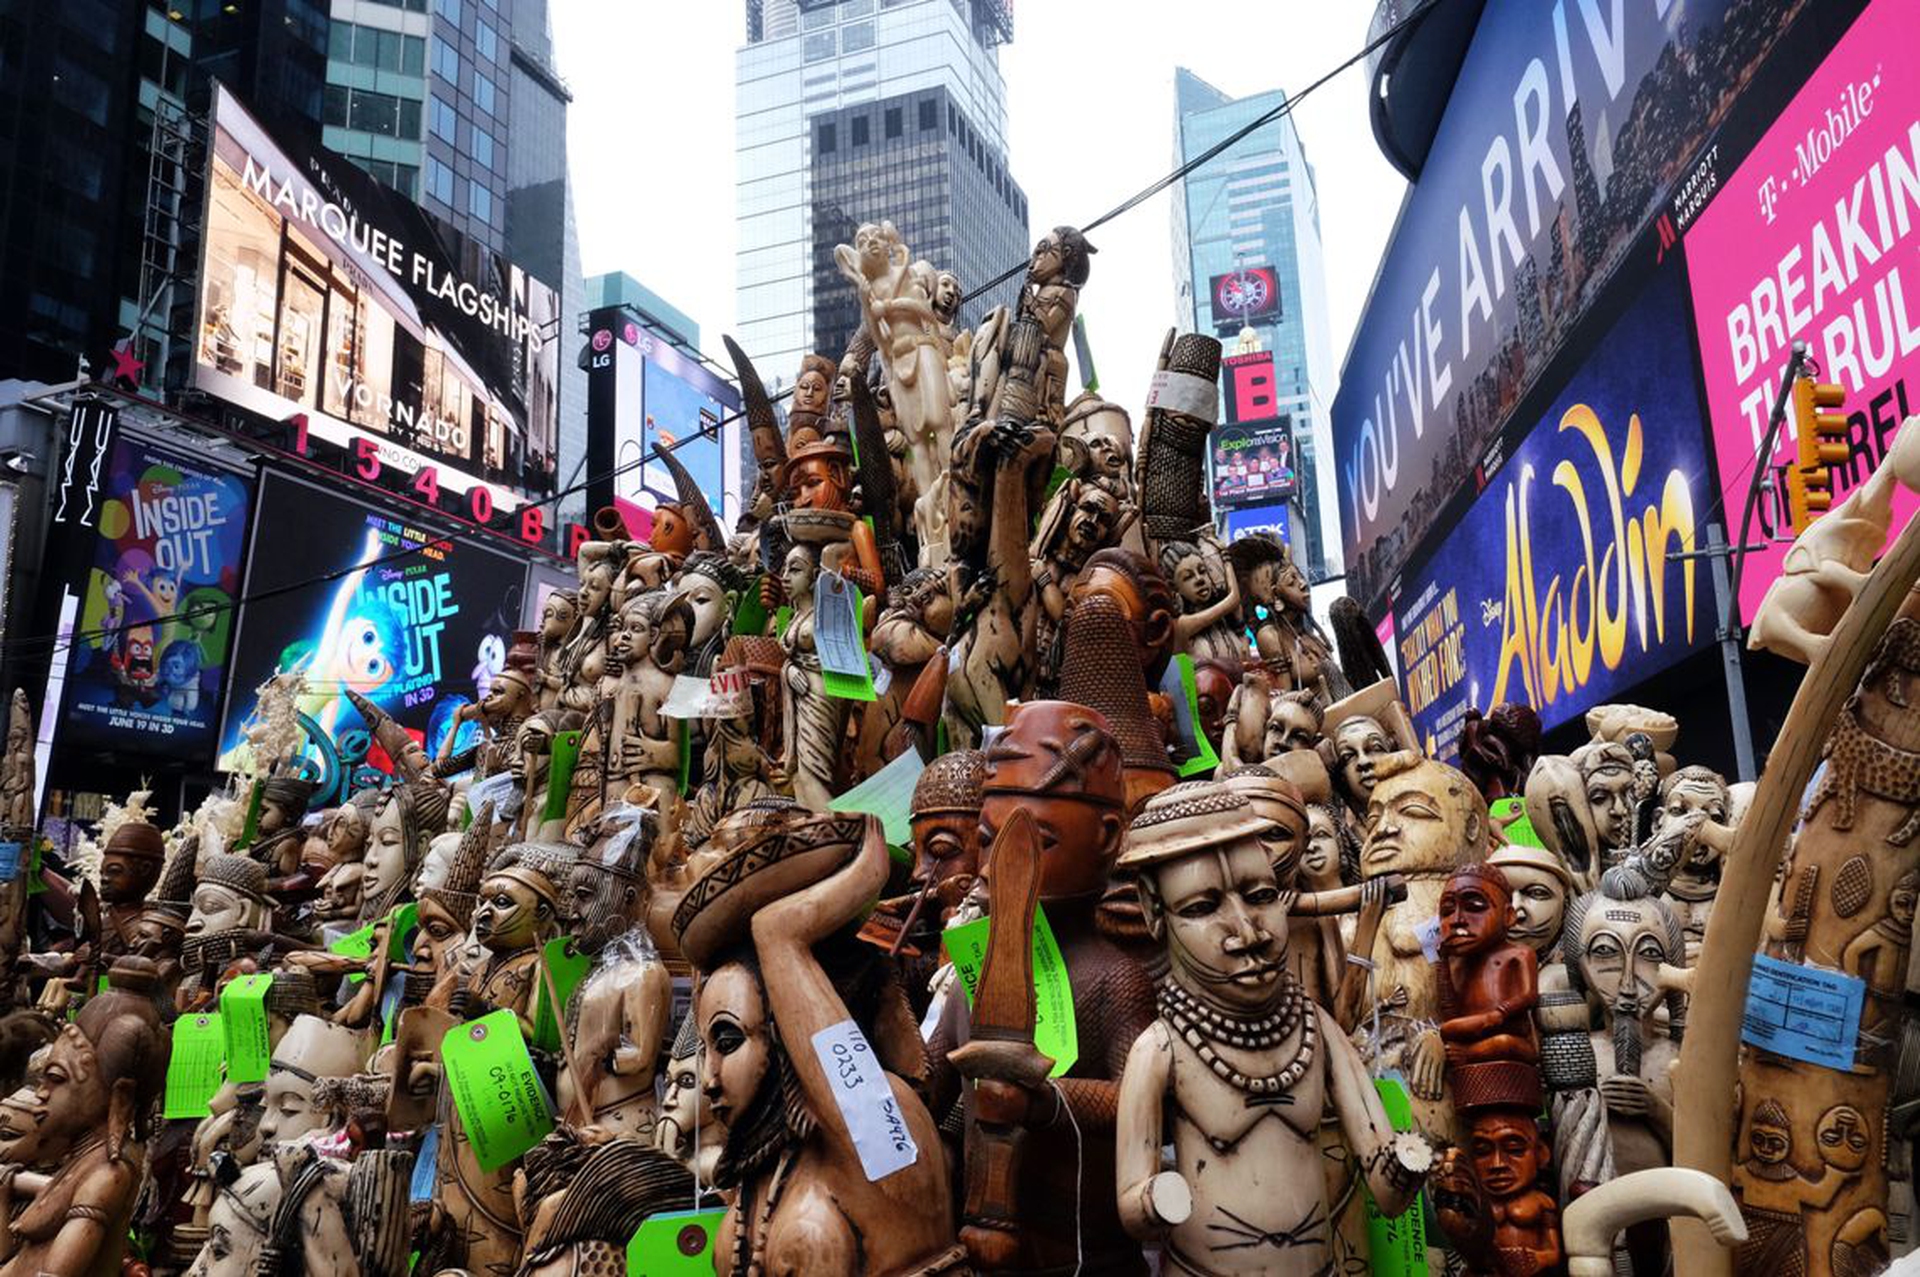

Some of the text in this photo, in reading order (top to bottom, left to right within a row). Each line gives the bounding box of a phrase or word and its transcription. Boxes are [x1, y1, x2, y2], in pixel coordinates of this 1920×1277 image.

[1674, 144, 1719, 211] MARRIOTT
[1676, 172, 1717, 230] MARQUIS
[241, 154, 543, 353] MARQUEE FLAGSHIPS
[1345, 0, 1673, 545] YOU'VE ARRIV
[592, 354, 611, 368] LG
[1223, 351, 1272, 366] TOSHIBA
[334, 362, 467, 450] VORNADO
[131, 488, 227, 540] INSIDE
[155, 529, 211, 576] OUT
[1483, 403, 1695, 712] Aladdin
[403, 621, 446, 683] UT
[404, 691, 418, 708] IN
[419, 685, 435, 704] 3D
[108, 716, 175, 735] JUNE 19 IN 3D
[832, 1043, 865, 1090] 0233
[521, 1069, 547, 1123] EVIDENCE
[1410, 1193, 1425, 1264] IDENCE
